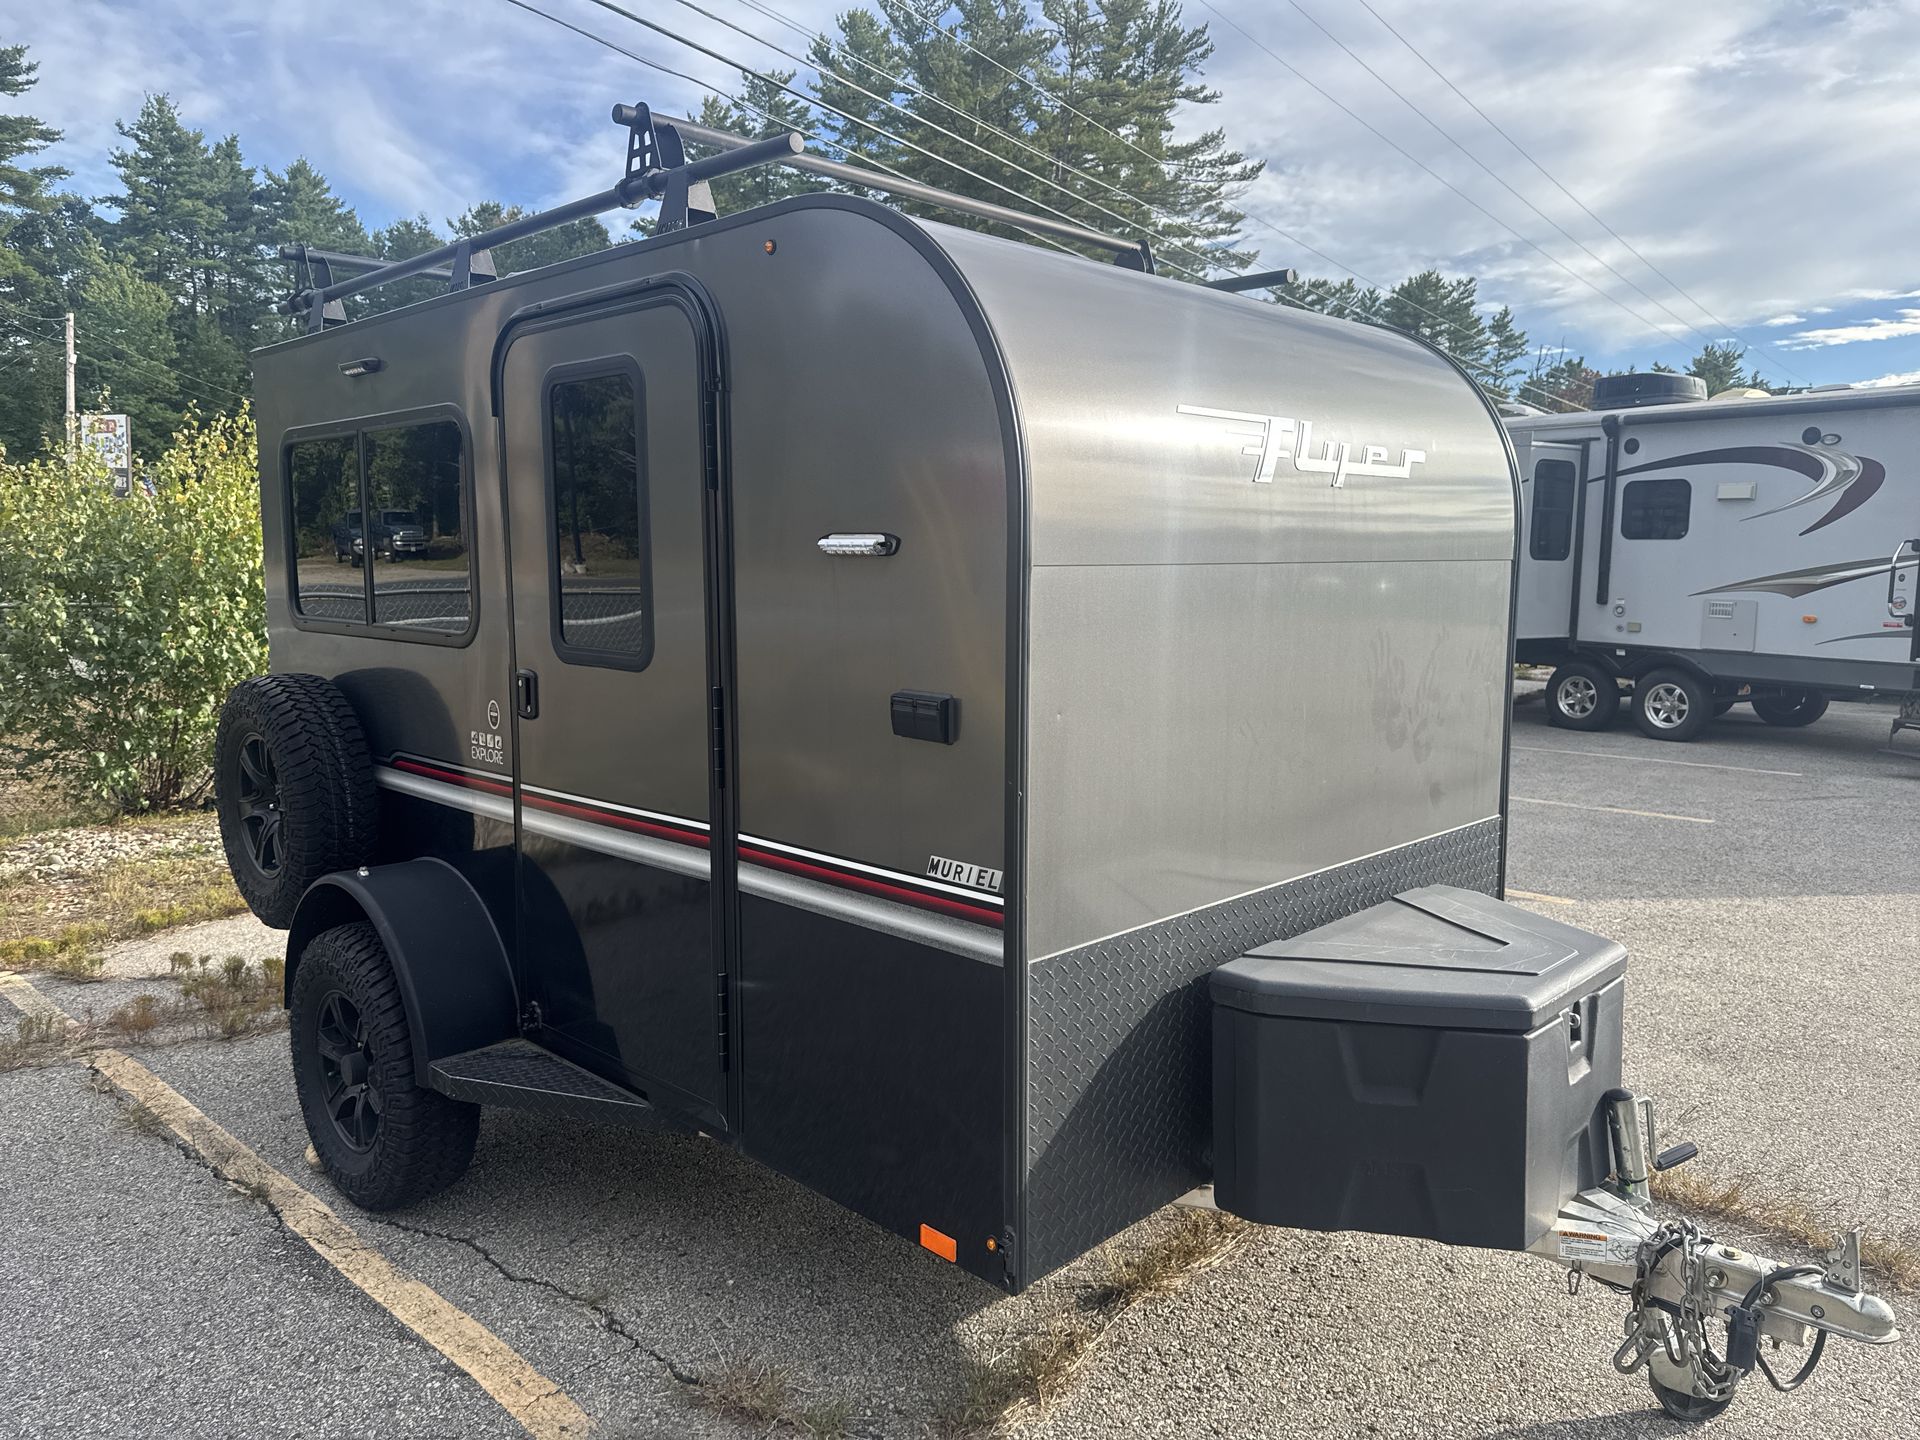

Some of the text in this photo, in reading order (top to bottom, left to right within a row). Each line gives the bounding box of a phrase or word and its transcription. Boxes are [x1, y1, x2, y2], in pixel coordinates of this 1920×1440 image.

[1176, 404, 1427, 488] Flyer
[471, 746, 504, 765] EXPLORE
[927, 857, 998, 890] MURIEL
[1568, 1231, 1602, 1241] WARNING
